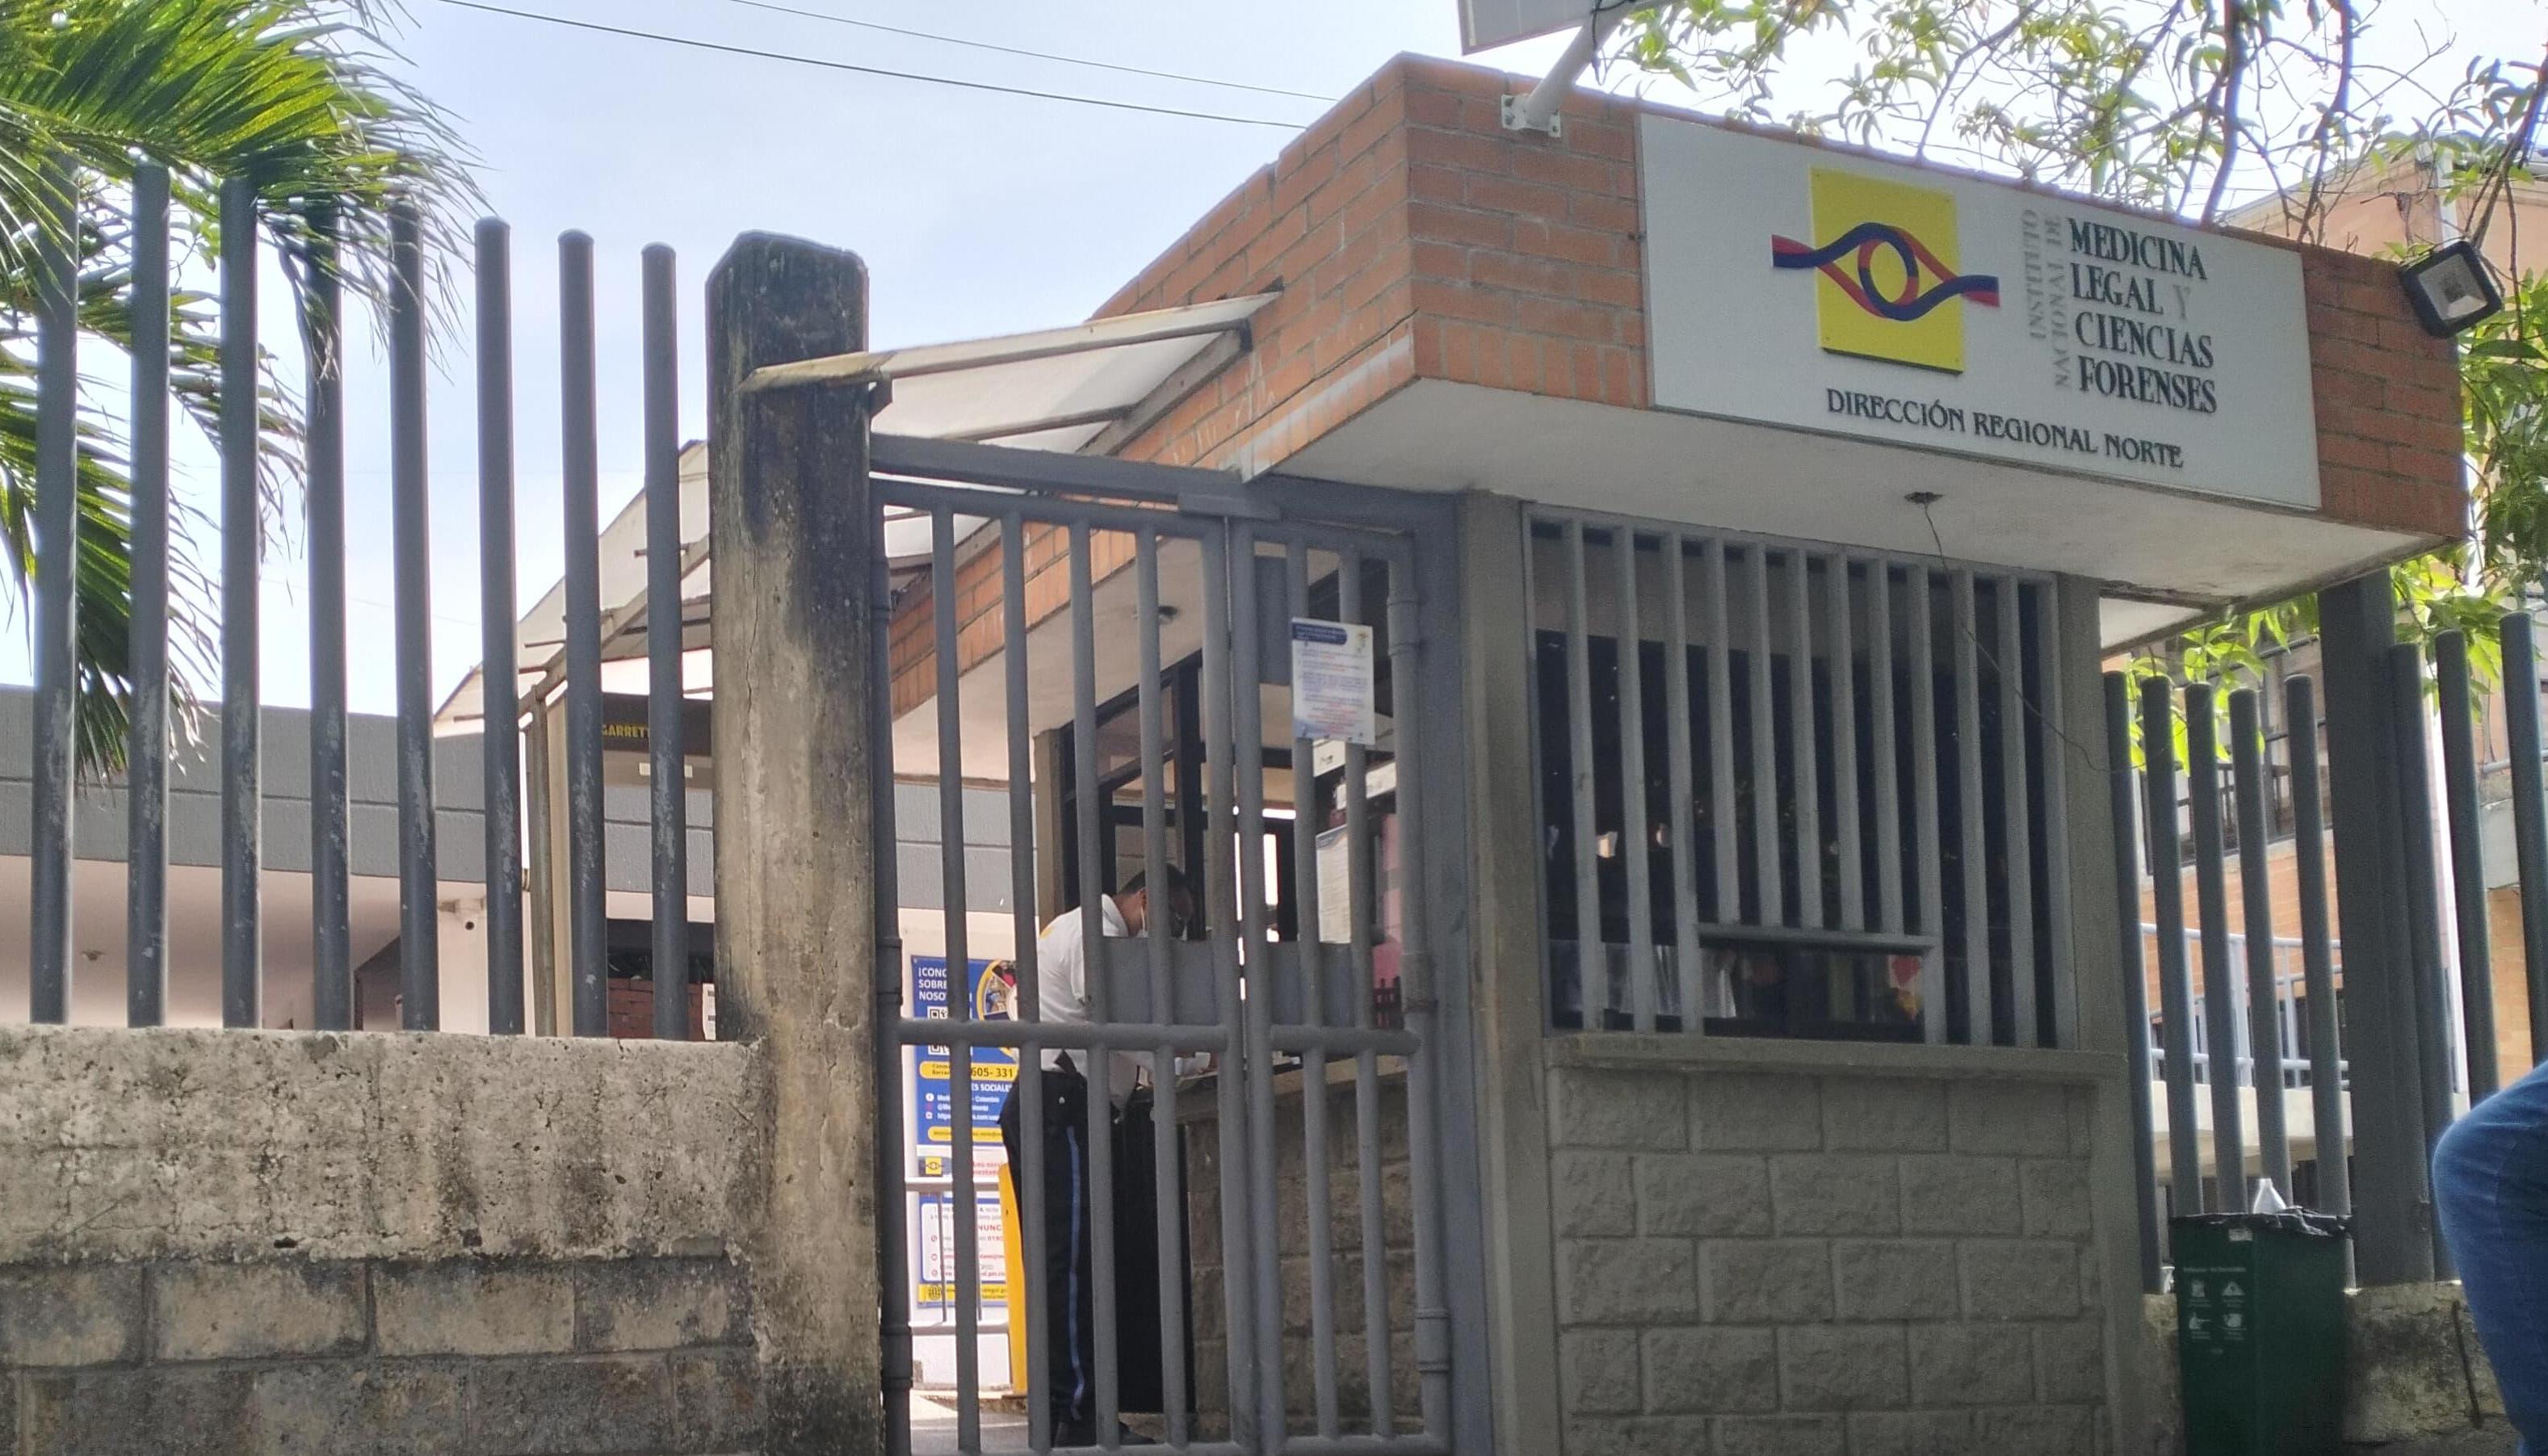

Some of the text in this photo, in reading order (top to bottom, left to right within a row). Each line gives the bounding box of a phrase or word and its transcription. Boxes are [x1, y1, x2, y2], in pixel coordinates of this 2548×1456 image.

[2067, 217, 2207, 280] MEDICINA
[2070, 262, 2192, 321] LEGAL Y
[2076, 311, 2214, 368] CIENCIAS
[2078, 355, 2218, 413] FORENSES
[1827, 388, 2184, 468] DIRECCIÓN REGIONAL NORTE
